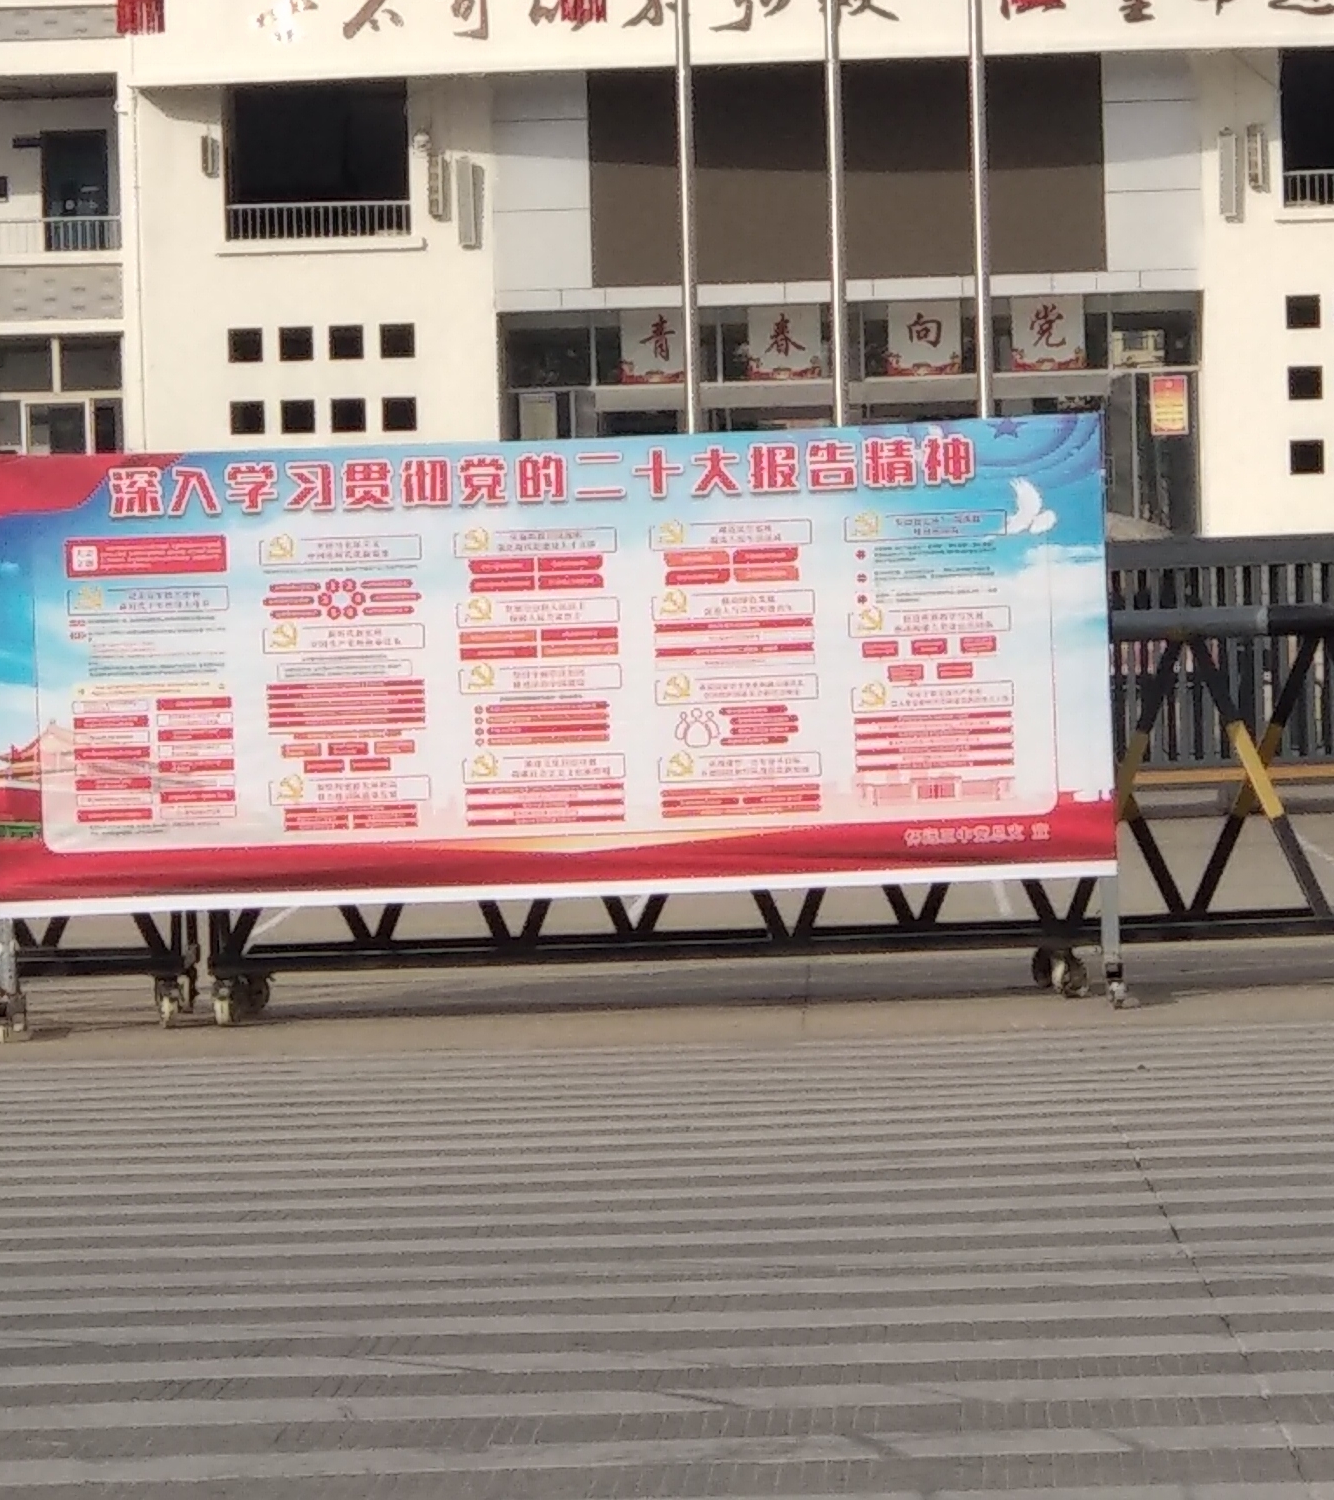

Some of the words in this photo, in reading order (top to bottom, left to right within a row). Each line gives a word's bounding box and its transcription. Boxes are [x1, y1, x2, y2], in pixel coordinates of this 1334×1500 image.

[638, 301, 1069, 363] 青春向党
[107, 432, 977, 520] 深入学习贯彻党的二十大报告精神
